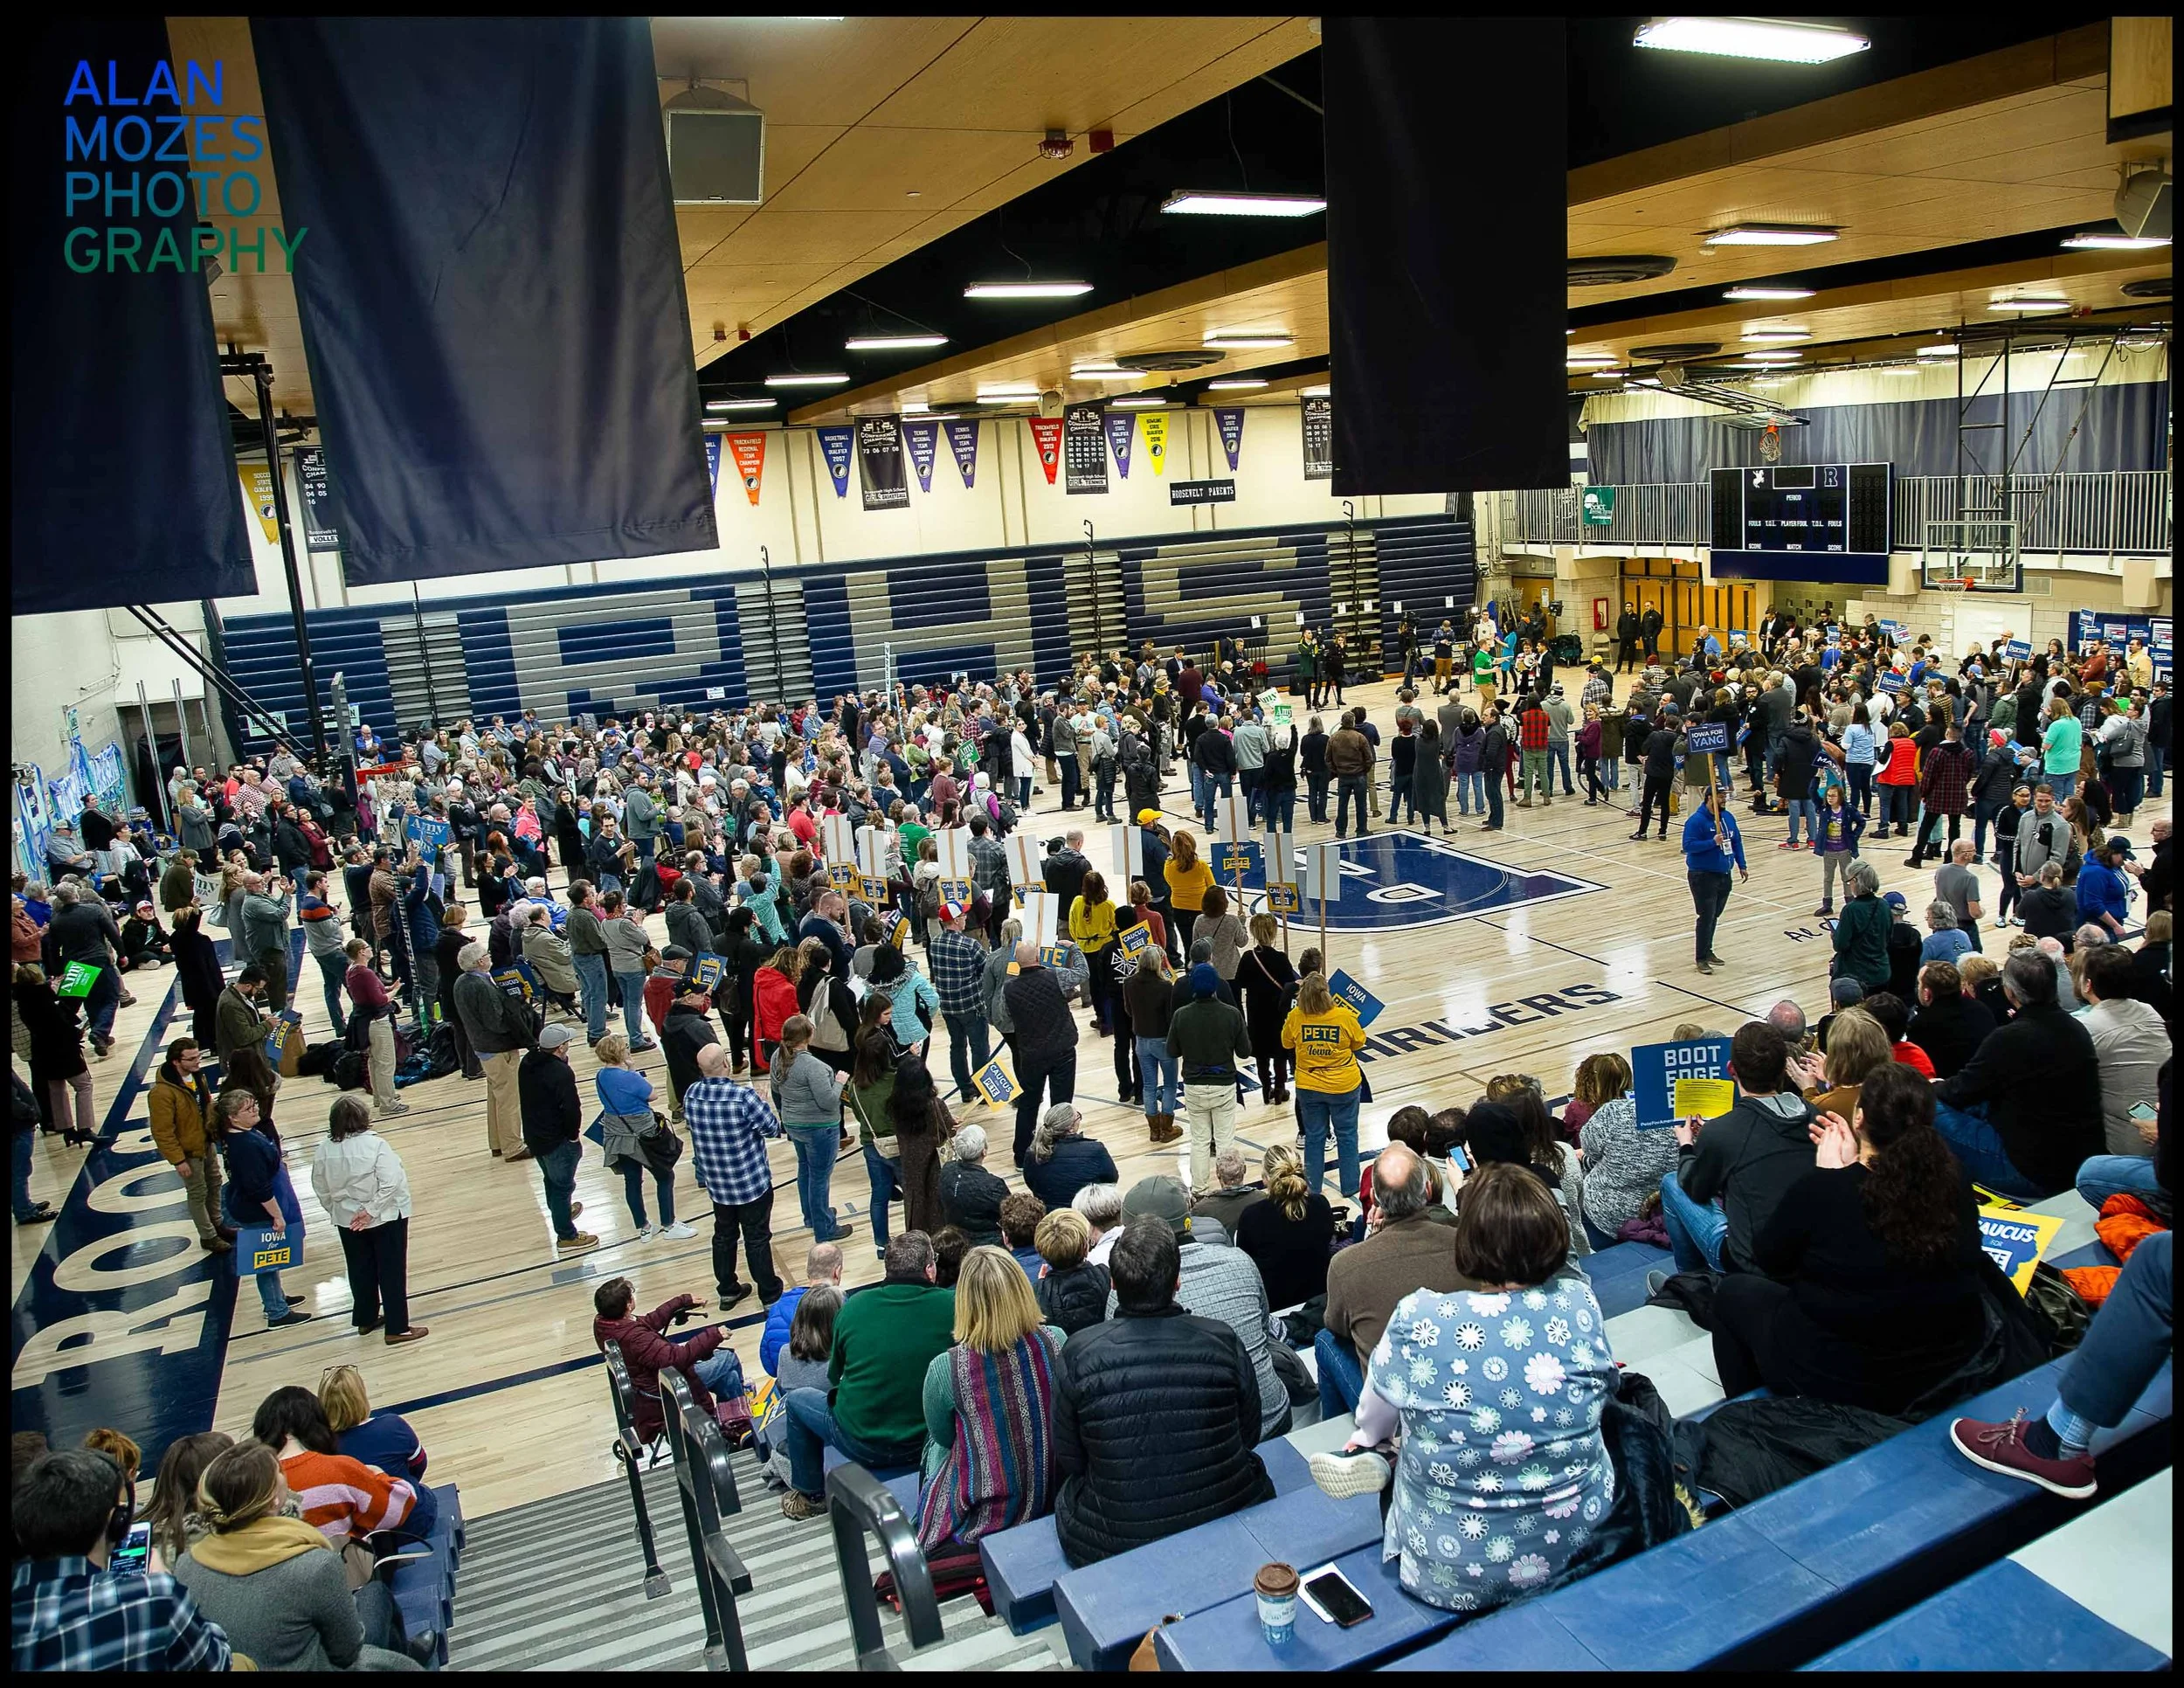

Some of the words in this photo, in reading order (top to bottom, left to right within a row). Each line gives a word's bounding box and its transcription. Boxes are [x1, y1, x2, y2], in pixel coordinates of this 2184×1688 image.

[1171, 488, 1203, 499] ROOSEVELT
[1209, 487, 1234, 496] PARENTS
[2008, 645, 2029, 655] Bernie
[1882, 676, 1904, 688] Bernie
[1693, 736, 1724, 746] YANG
[410, 818, 446, 834] Amy
[196, 877, 218, 893] my
[1123, 928, 1144, 942] CAUCUS
[1131, 939, 1144, 949] PETE
[1042, 948, 1066, 966] TE
[61, 961, 86, 993] Amy
[1346, 983, 1366, 1003] IOWA
[1304, 1027, 1337, 1040] PETE
[1308, 1046, 1333, 1056] Iowa
[1664, 1045, 1721, 1067] BOOT
[990, 1065, 1013, 1093] CAUCUS
[985, 1079, 999, 1095] PETE
[261, 1232, 286, 1242] IOWA
[1978, 1220, 2037, 1242] AUCUS
[257, 1250, 288, 1265] PETE
